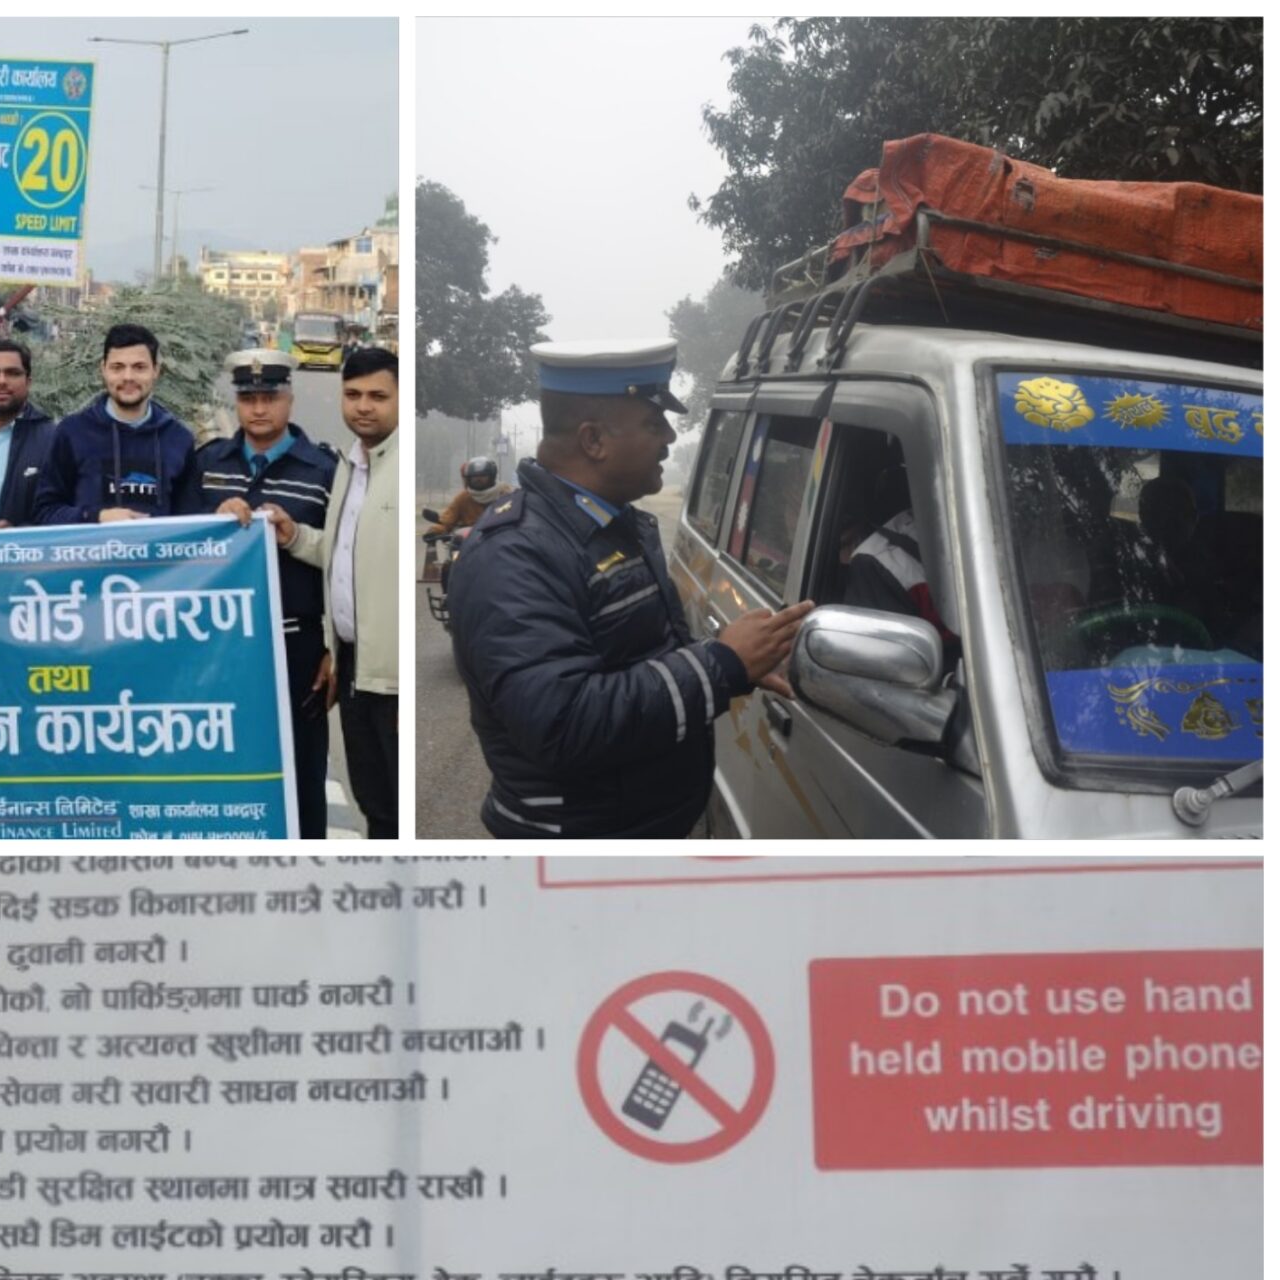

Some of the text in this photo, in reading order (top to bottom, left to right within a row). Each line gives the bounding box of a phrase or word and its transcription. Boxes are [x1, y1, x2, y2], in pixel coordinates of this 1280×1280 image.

[12, 67, 57, 87] कार्यालय
[22, 128, 79, 191] 20
[15, 215, 77, 232] SPEED LIMIT
[10, 579, 86, 643] बोर्ड
[102, 575, 255, 642] वितरण
[28, 665, 91, 694] तथा
[36, 690, 235, 757] कार्यक्रम
[49, 894, 119, 919] सडक
[130, 887, 255, 918] किनारामा
[267, 884, 321, 914] मात्रै
[333, 883, 401, 914] रोक्ने
[61, 982, 98, 1010] नो
[253, 980, 308, 1008] पार्क
[879, 978, 1252, 1018] Do not use hand
[70, 1036, 86, 1059] र
[98, 1032, 196, 1058] अत्यन्त
[208, 1027, 301, 1061] खुशीमा
[313, 1025, 390, 1054] सवारी
[851, 1039, 1262, 1079] held mobile phone
[0, 1076, 61, 1107] सेवन
[72, 1076, 120, 1106] गरी
[132, 1075, 210, 1105] सवारी
[221, 1078, 297, 1105] साधन
[925, 1095, 1222, 1136] whilst driving
[15, 1124, 86, 1156] प्रयोग
[37, 1169, 133, 1206] सुरक्षित
[145, 1172, 248, 1202] स्थानमा
[260, 1173, 315, 1201] मात्र
[328, 1168, 406, 1201] सवारी
[51, 1219, 101, 1248] डिम
[113, 1217, 222, 1251] लाईटको
[234, 1218, 308, 1252] प्रयोग
